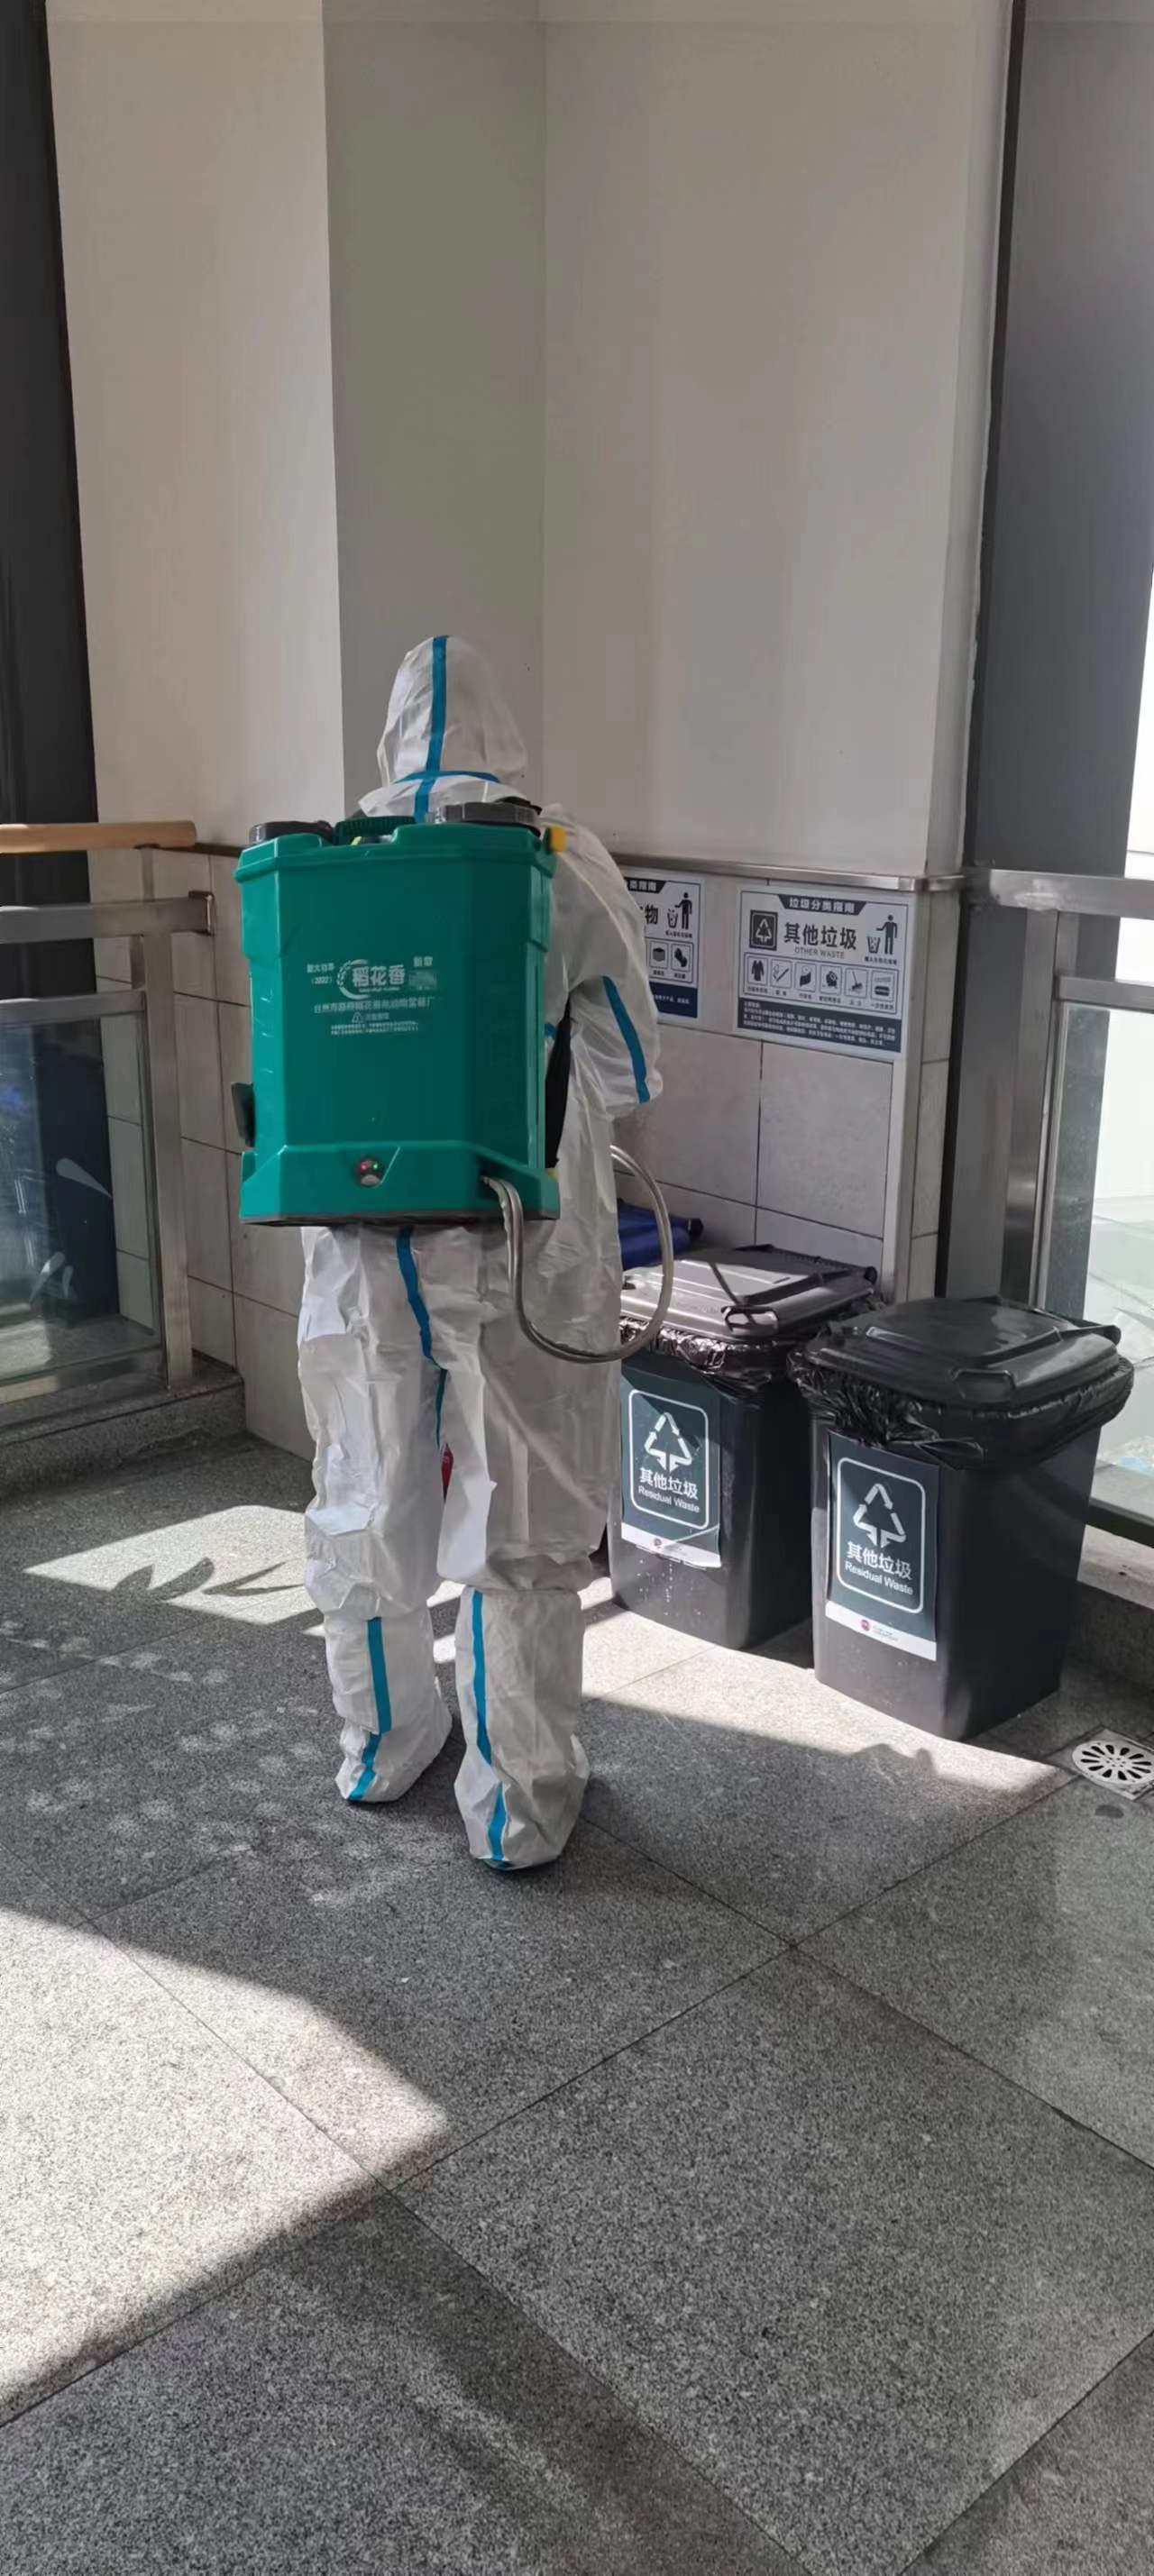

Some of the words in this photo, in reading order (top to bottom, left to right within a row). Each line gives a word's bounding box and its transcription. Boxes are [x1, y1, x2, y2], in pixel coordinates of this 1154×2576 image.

[629, 879, 657, 892] 类指南
[640, 904, 659, 926] 物
[783, 921, 857, 951] 其他垃圾
[794, 947, 820, 956] OTHER
[820, 950, 845, 959] WASTE
[353, 964, 406, 987] 稻花香
[639, 1467, 699, 1500] 其他垃圾
[638, 1485, 672, 1504] Residual
[673, 1498, 700, 1512] Waste
[847, 1541, 912, 1580] 其他垃圾
[845, 1561, 883, 1584] Residual
[883, 1576, 914, 1595] Waste
